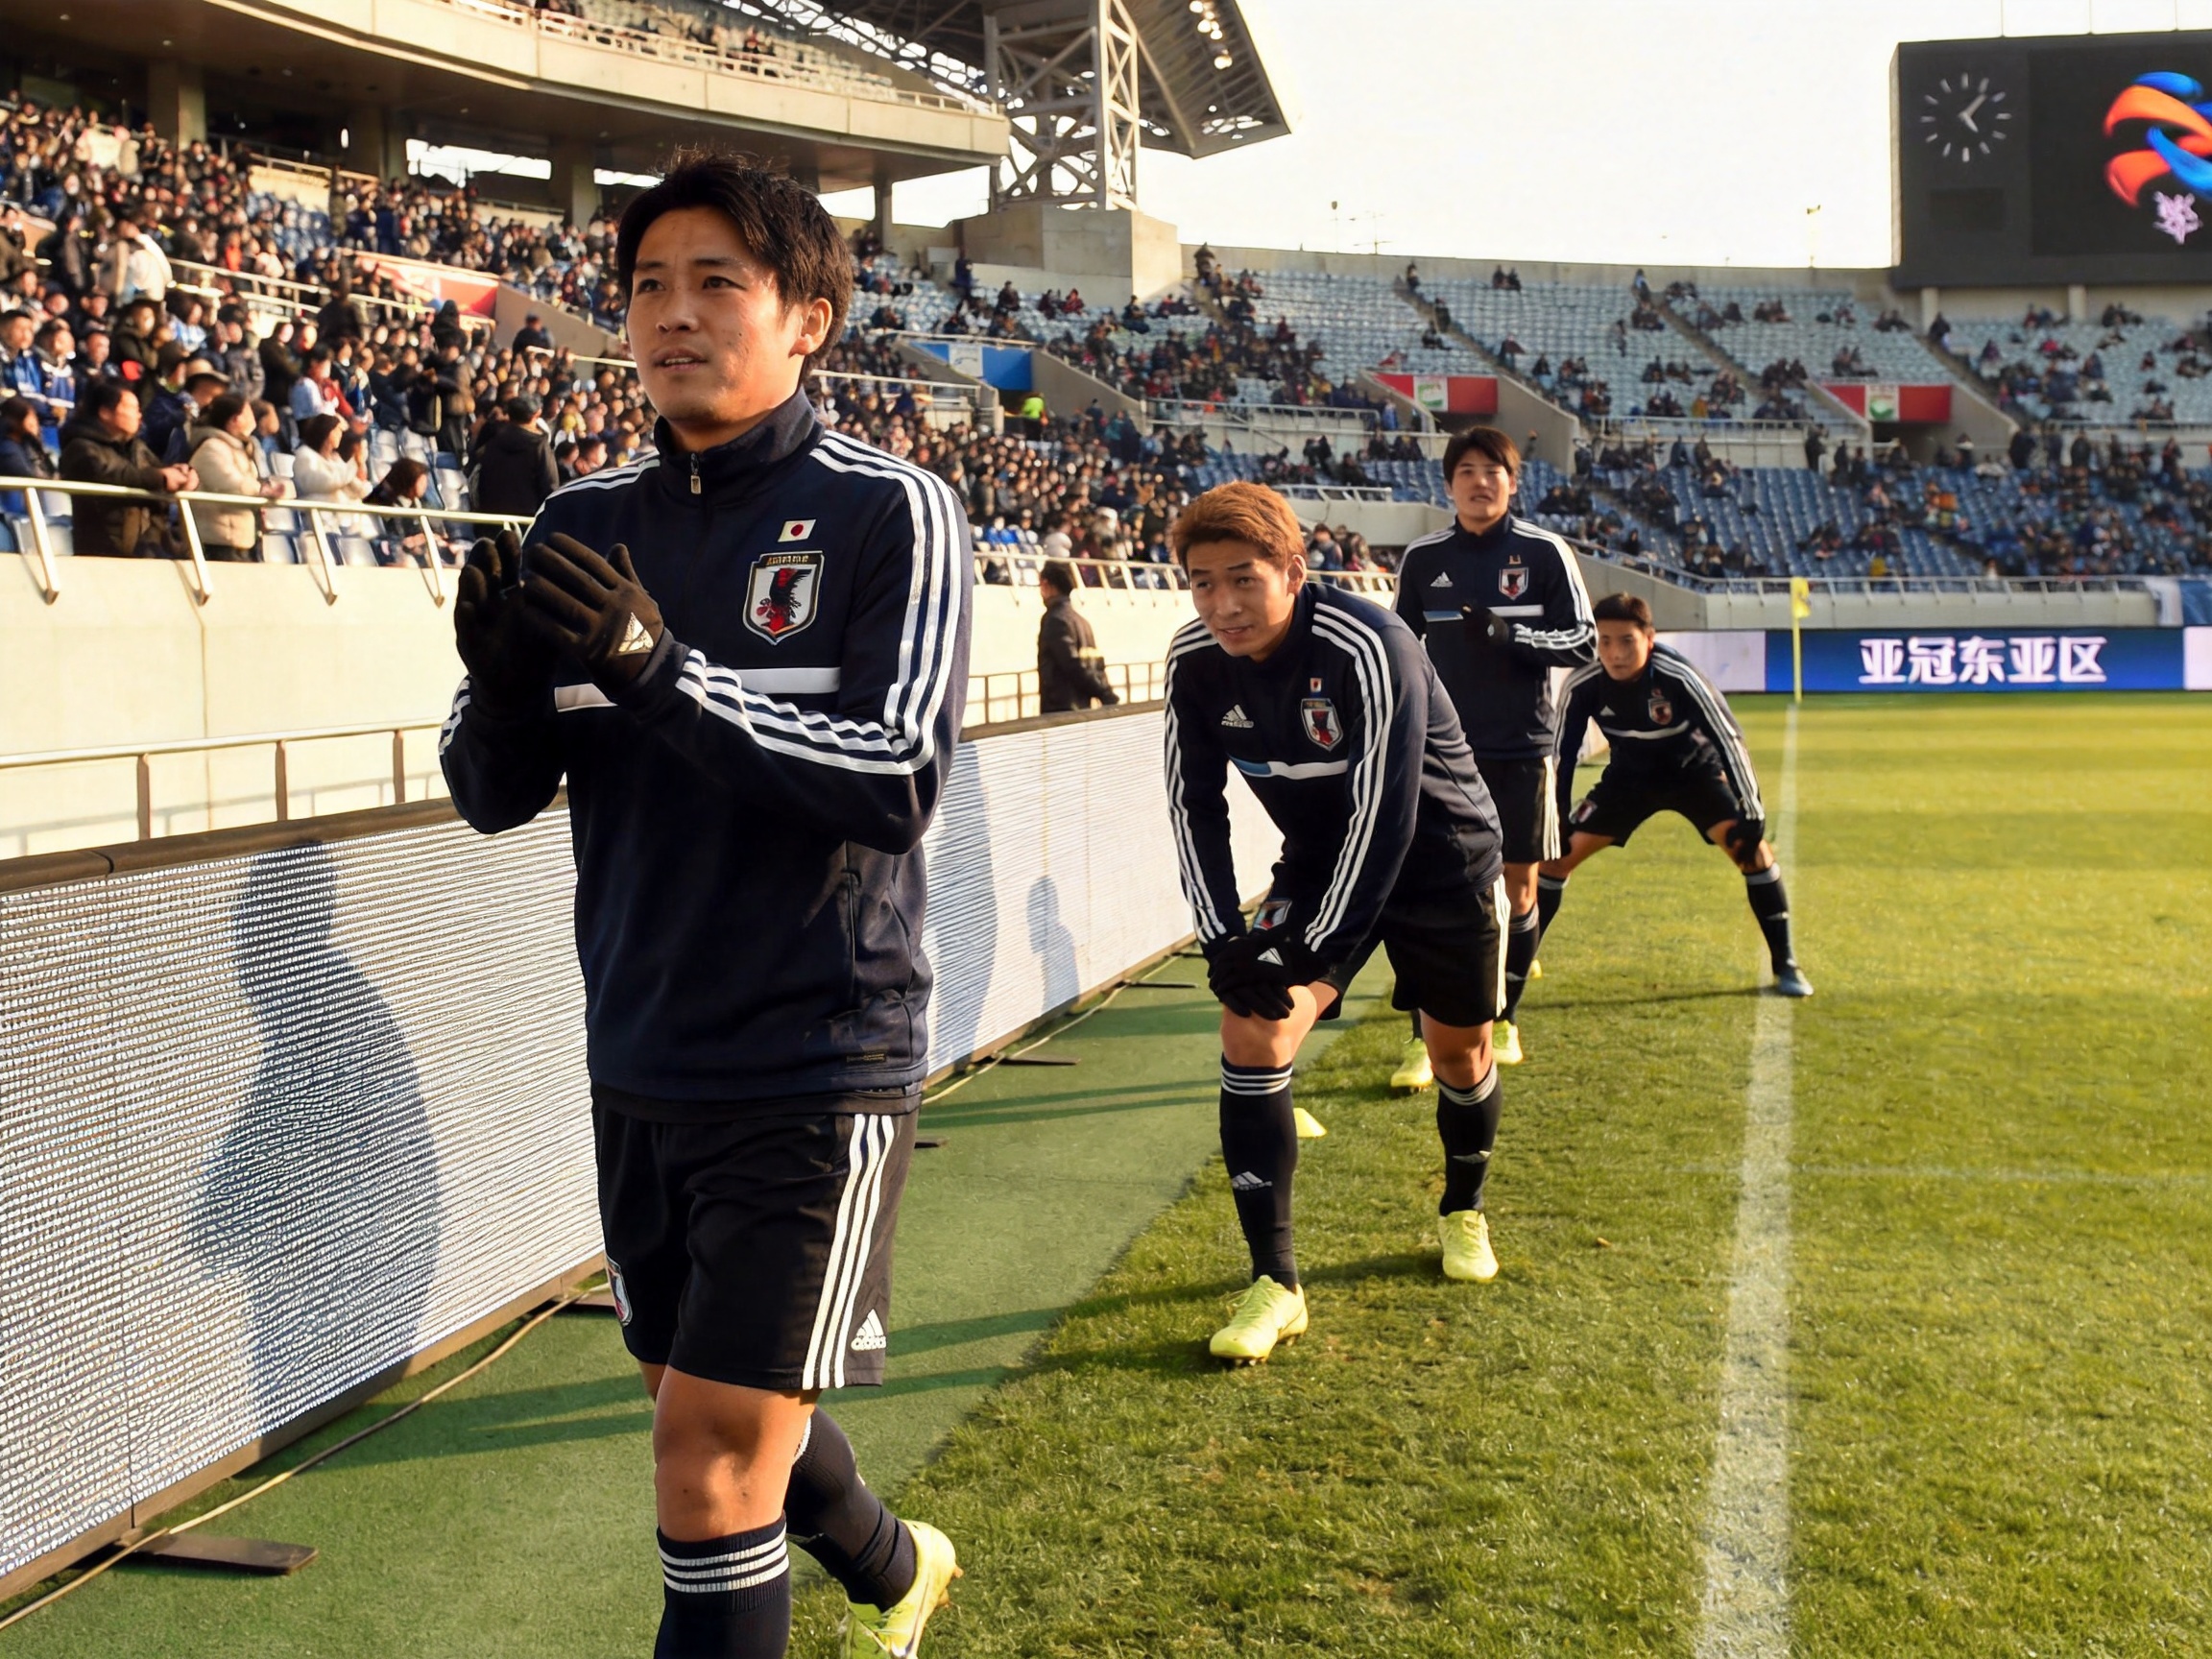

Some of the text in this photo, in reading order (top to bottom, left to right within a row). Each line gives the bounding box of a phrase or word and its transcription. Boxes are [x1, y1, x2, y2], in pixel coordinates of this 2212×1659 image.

[1859, 636, 2107, 685] 亚冠东亚区
